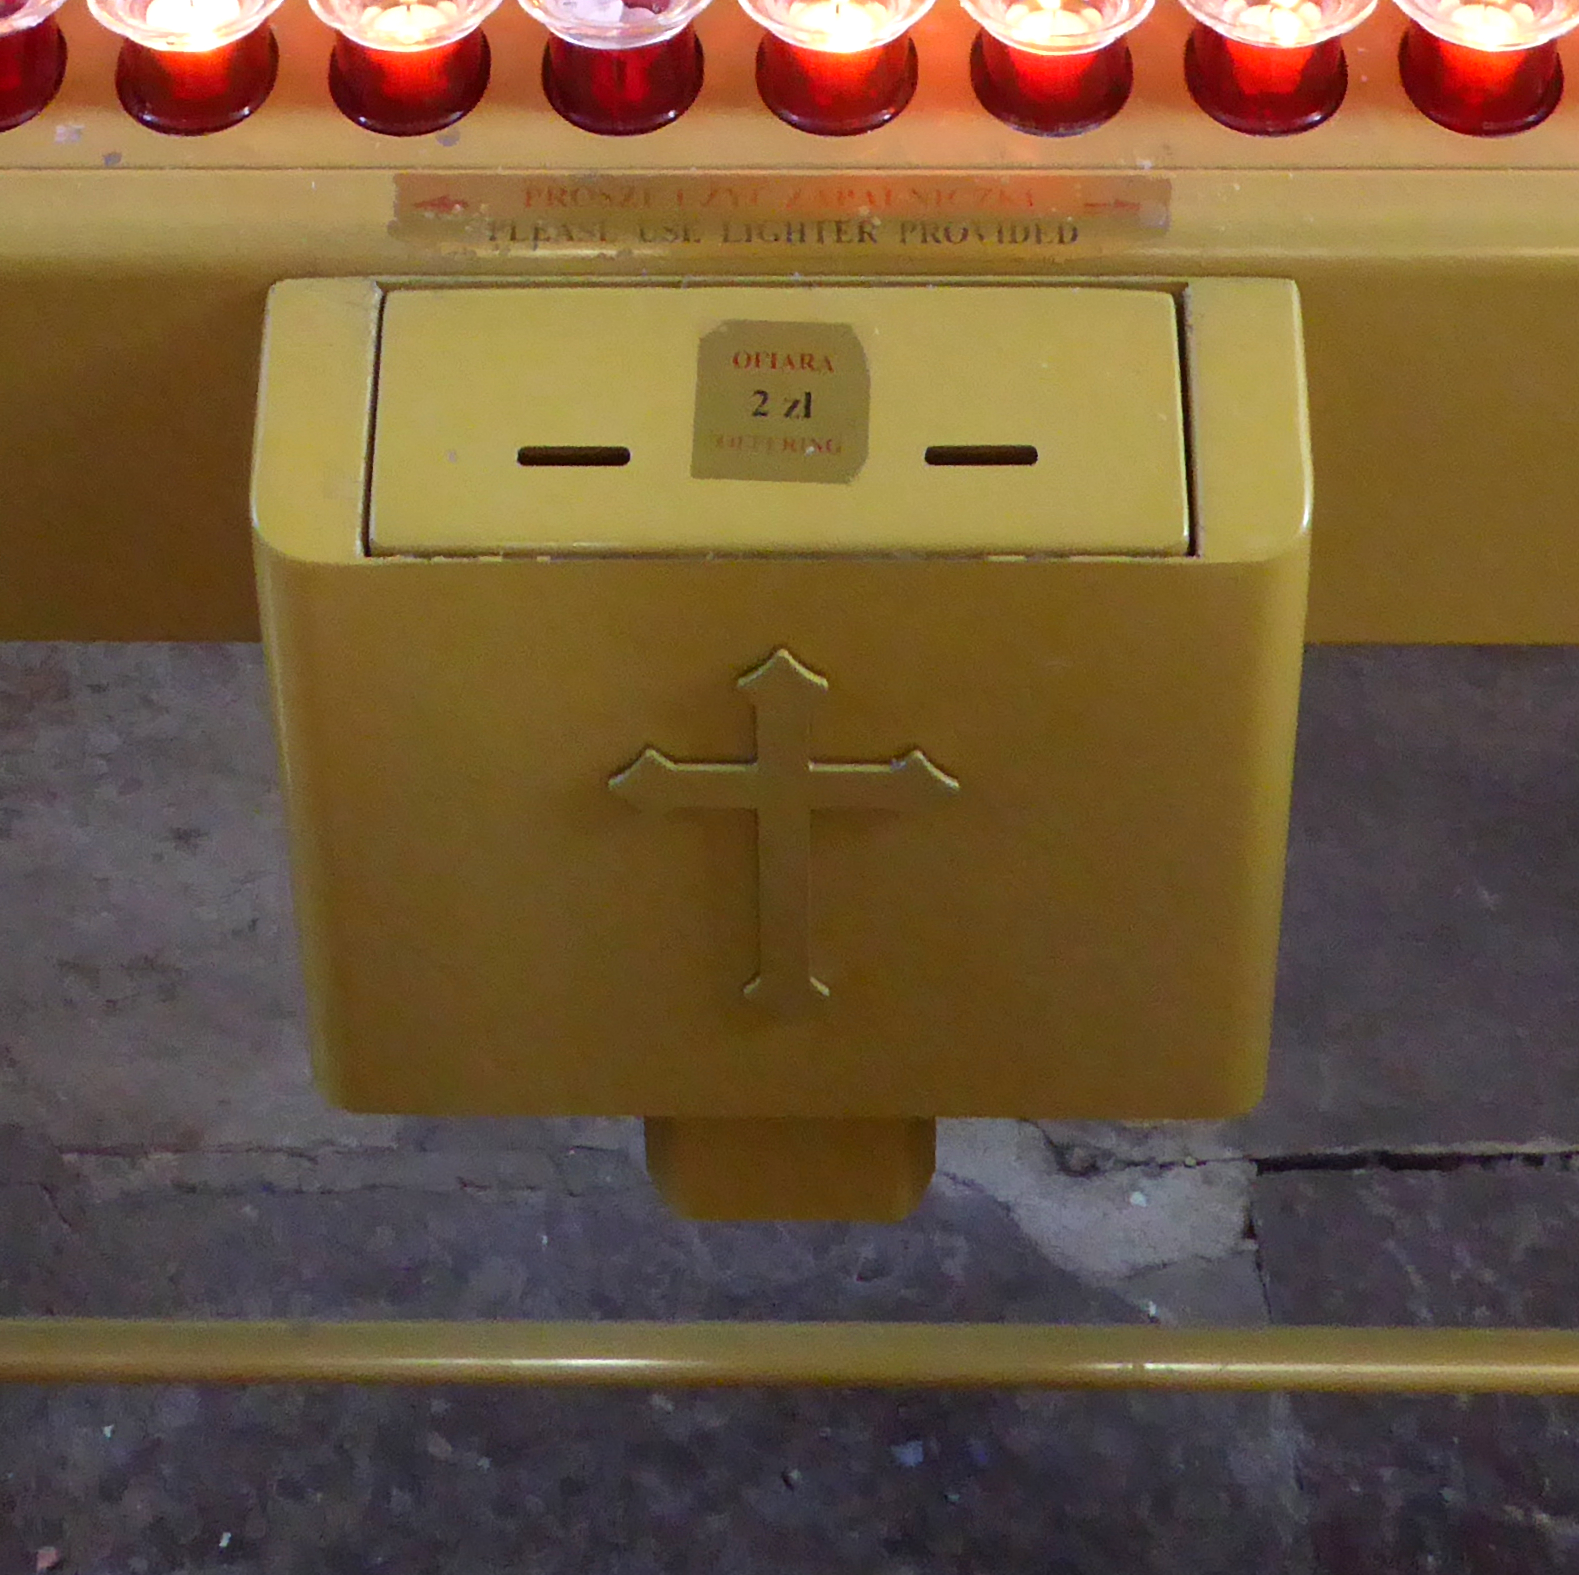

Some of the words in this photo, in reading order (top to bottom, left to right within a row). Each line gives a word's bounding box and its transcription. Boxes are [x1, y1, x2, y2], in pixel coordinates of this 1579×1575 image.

[486, 219, 616, 244] PLEASE
[638, 219, 701, 244] USE
[722, 220, 879, 245] LIGHTER
[898, 220, 1080, 245] PROVIDED
[731, 349, 835, 374] OFIARA
[750, 388, 770, 419] 2
